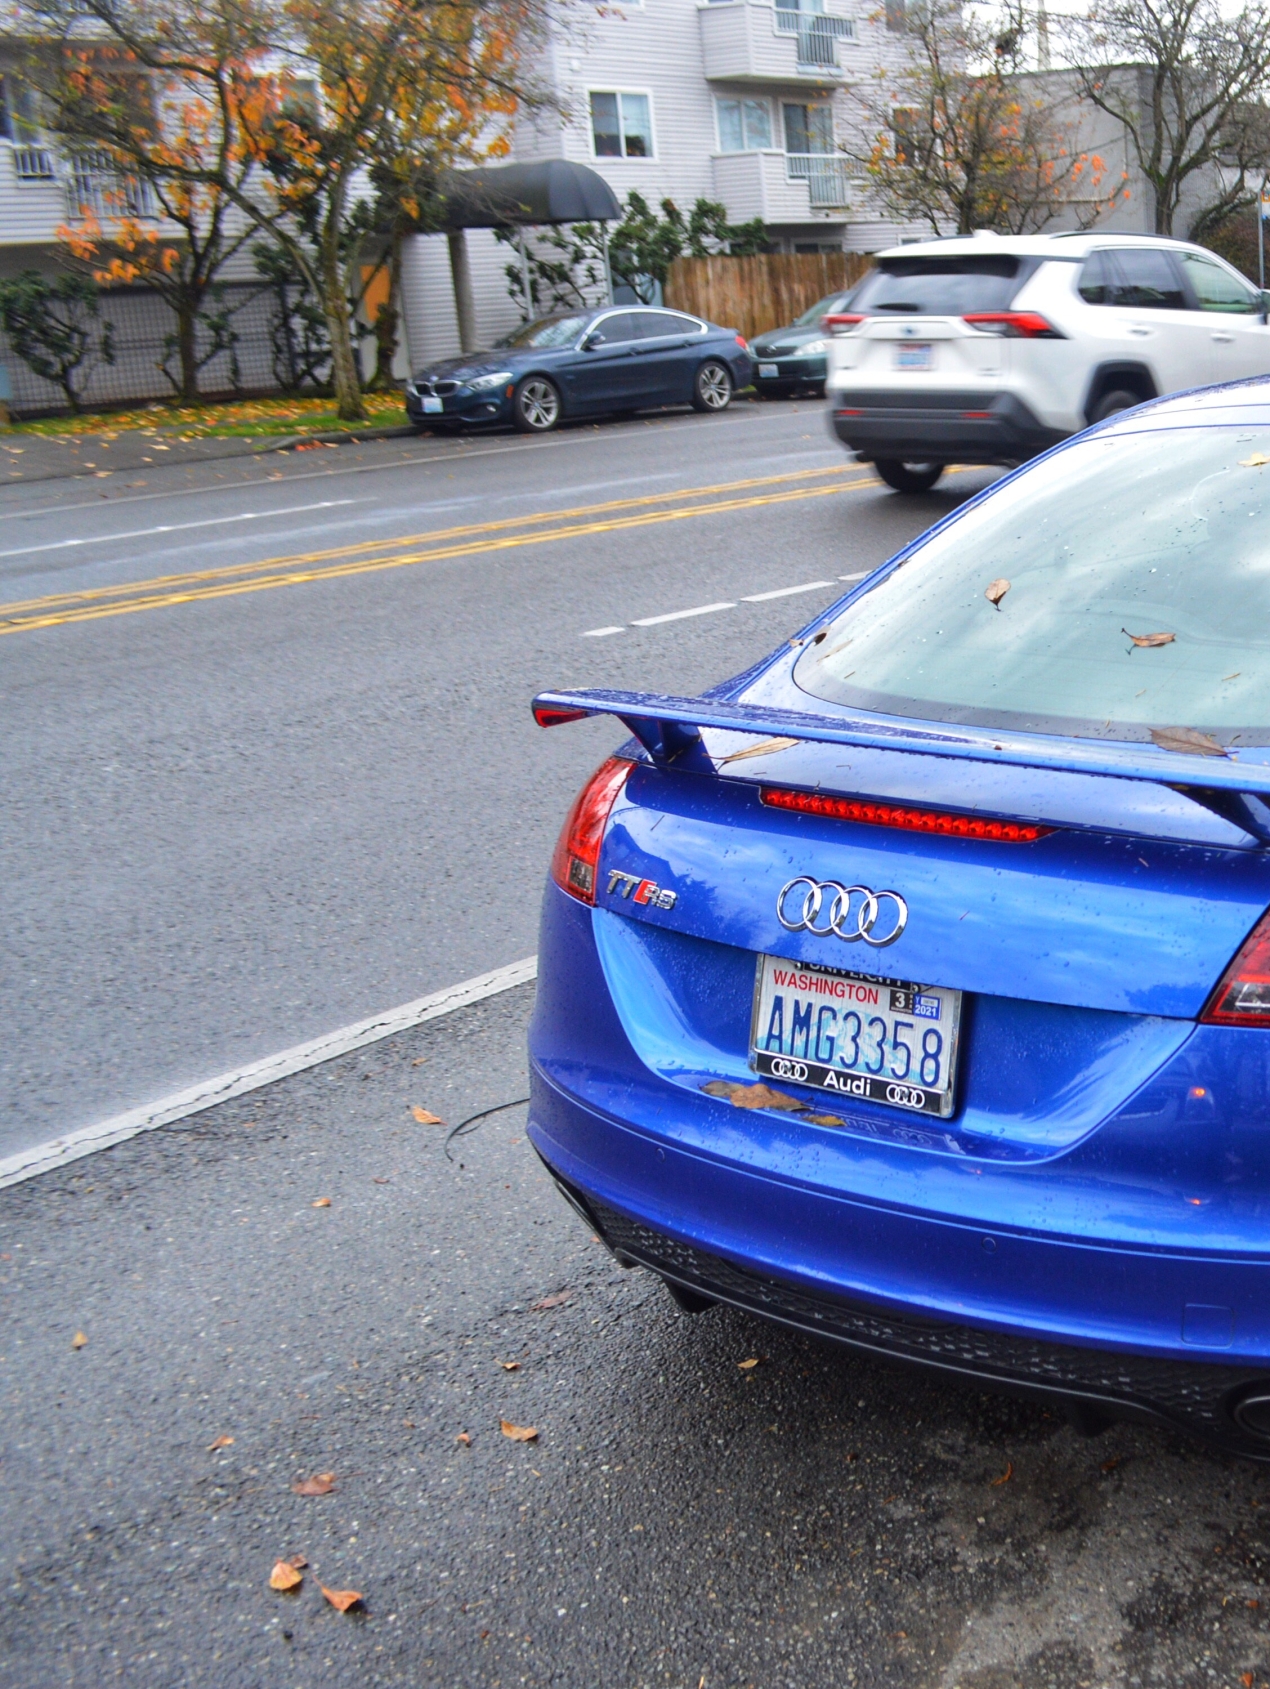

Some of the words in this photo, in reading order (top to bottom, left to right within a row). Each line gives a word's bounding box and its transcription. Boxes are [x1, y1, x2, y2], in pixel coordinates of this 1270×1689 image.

[773, 969, 879, 1005] WASHINGTON
[895, 992, 905, 1009] 3
[914, 1004, 936, 1017] 2021
[765, 995, 943, 1087] AMG3358
[823, 1071, 871, 1096] Audi
